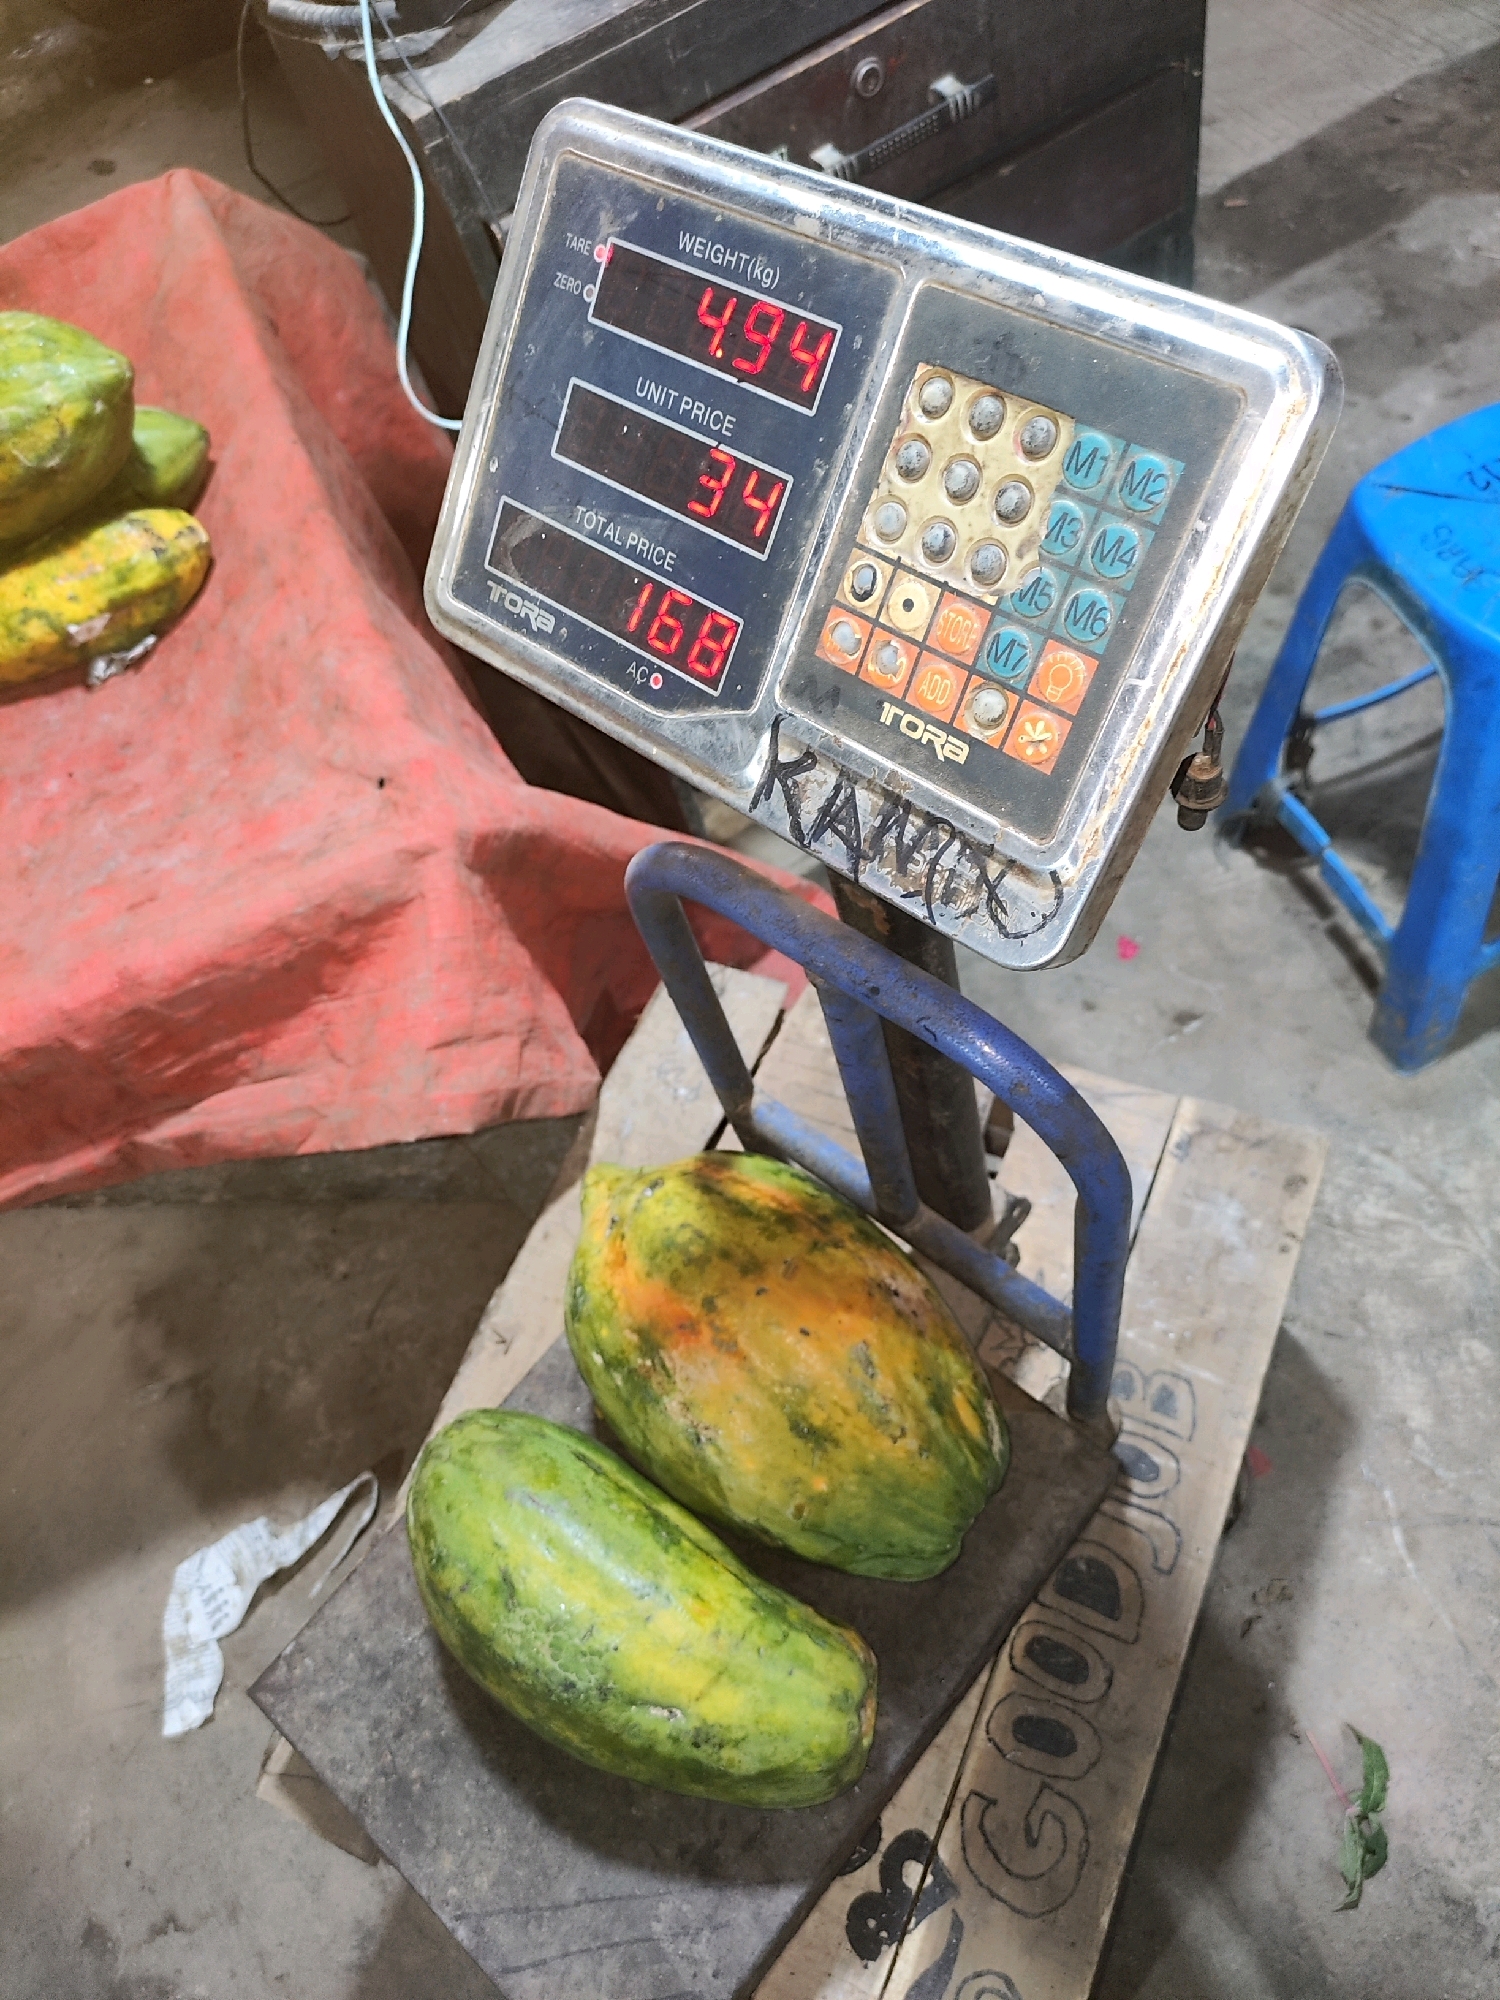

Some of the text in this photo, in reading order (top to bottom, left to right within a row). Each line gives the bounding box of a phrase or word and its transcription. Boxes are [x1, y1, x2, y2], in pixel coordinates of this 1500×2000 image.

[564, 232, 592, 256] TARE
[678, 231, 781, 289] WEIGHT(kg)
[553, 271, 582, 295] ZERO
[696, 286, 833, 392] 4.94
[635, 376, 737, 437] UNIT PRICE
[687, 447, 784, 537] 34
[1119, 460, 1169, 504] M2
[575, 505, 677, 572] TOTAL PRICE
[1090, 528, 1139, 568] M4
[627, 582, 737, 678] 168
[936, 609, 979, 649] STORE
[1063, 593, 1110, 637] M6
[626, 661, 649, 683] AC
[986, 632, 1029, 671] M7
[918, 671, 951, 705] ADD
[960, 1540, 1145, 1919] GOOD
